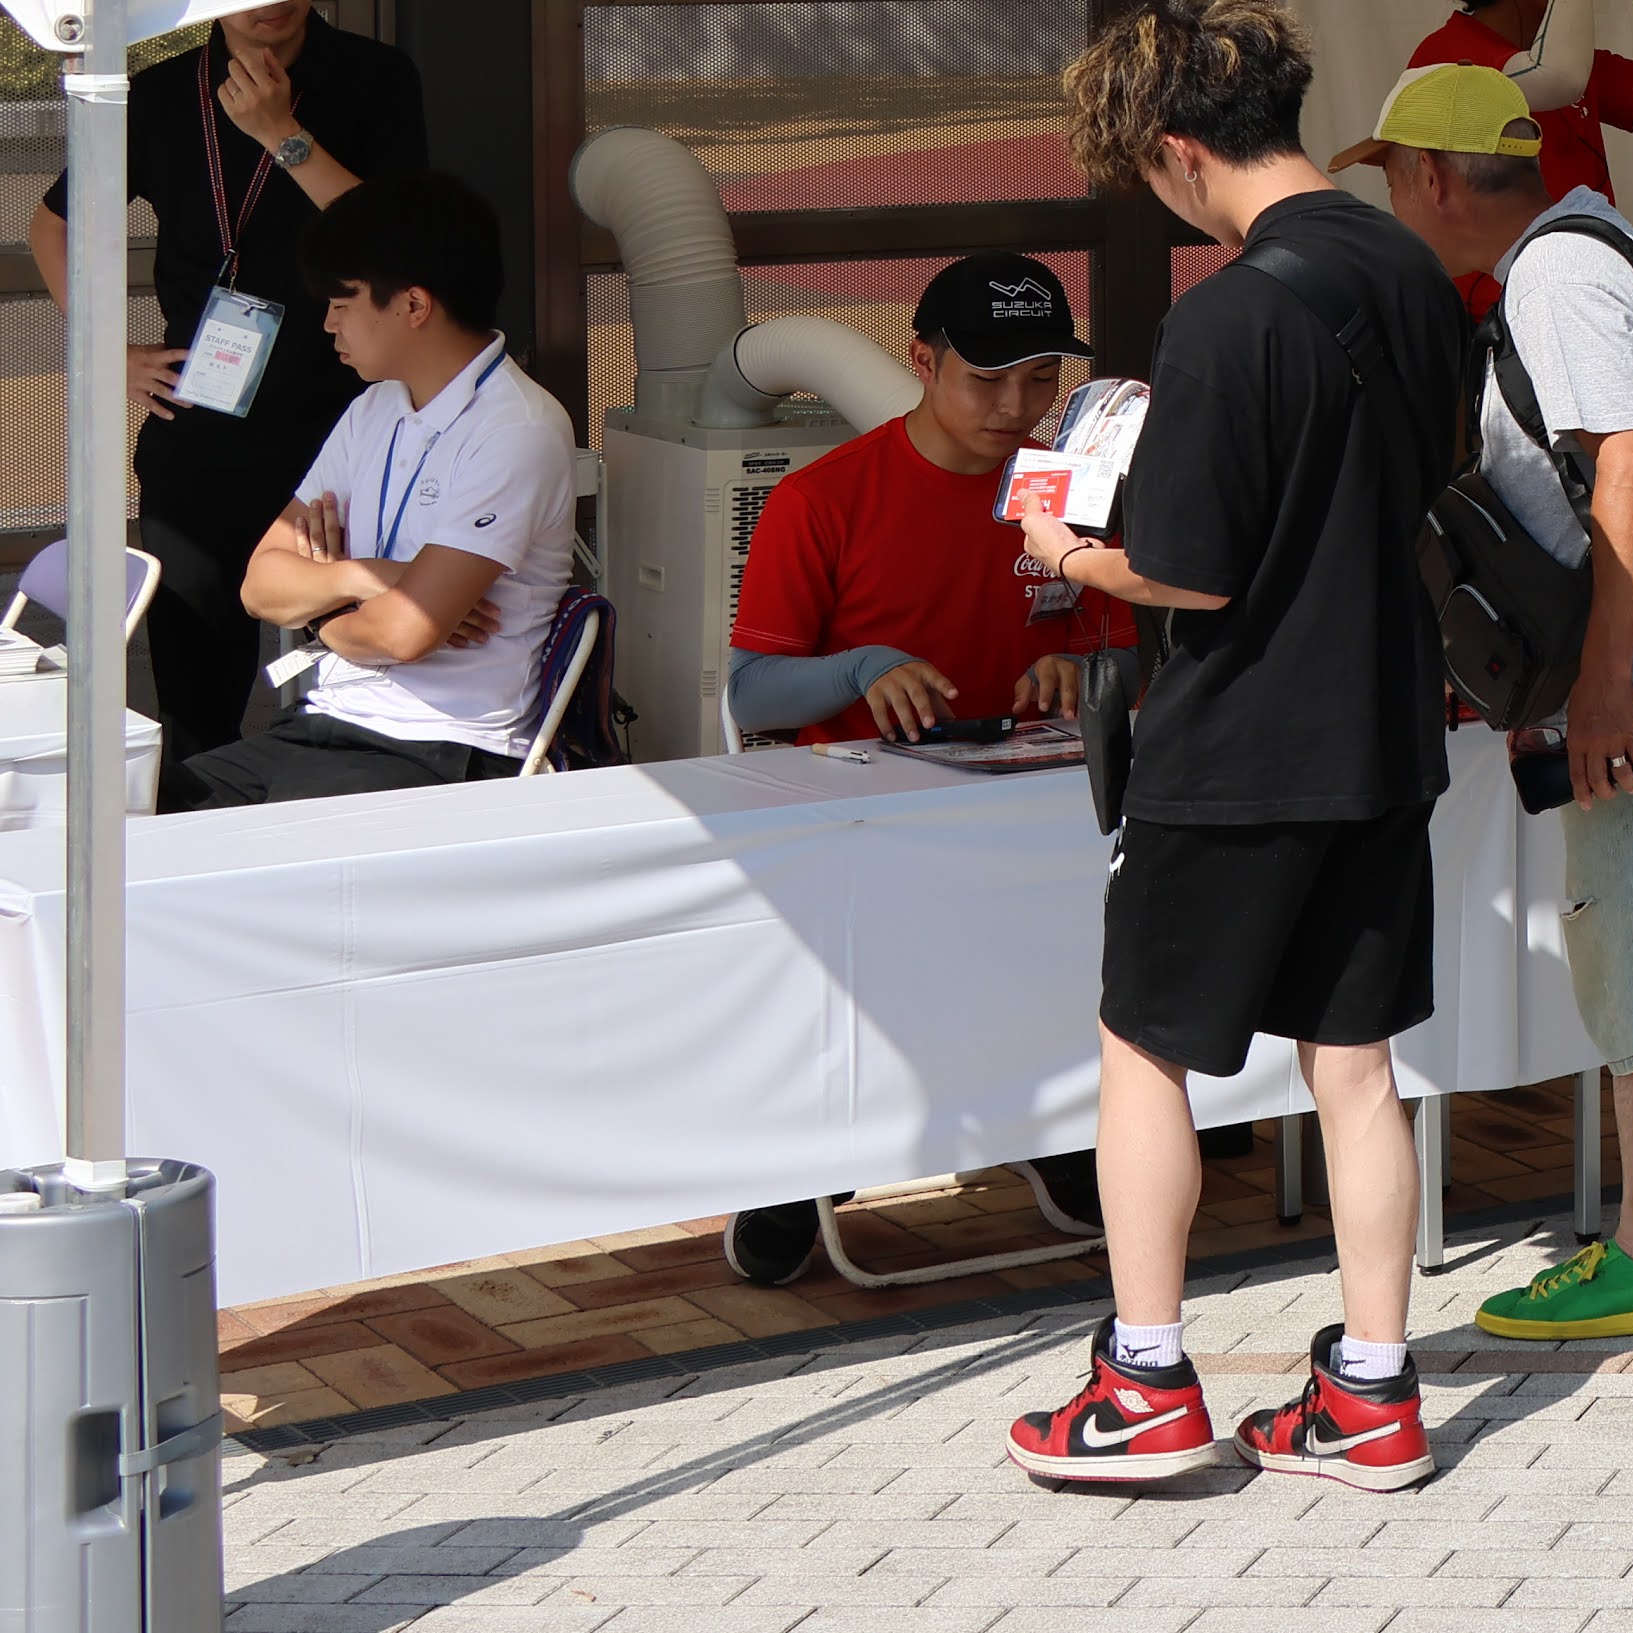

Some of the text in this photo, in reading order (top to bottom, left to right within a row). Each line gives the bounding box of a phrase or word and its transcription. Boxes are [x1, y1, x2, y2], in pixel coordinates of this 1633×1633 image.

[991, 301, 1053, 310] SUZUKA
[993, 309, 1053, 319] CIRCUIT
[205, 334, 253, 354] STAFF PASS
